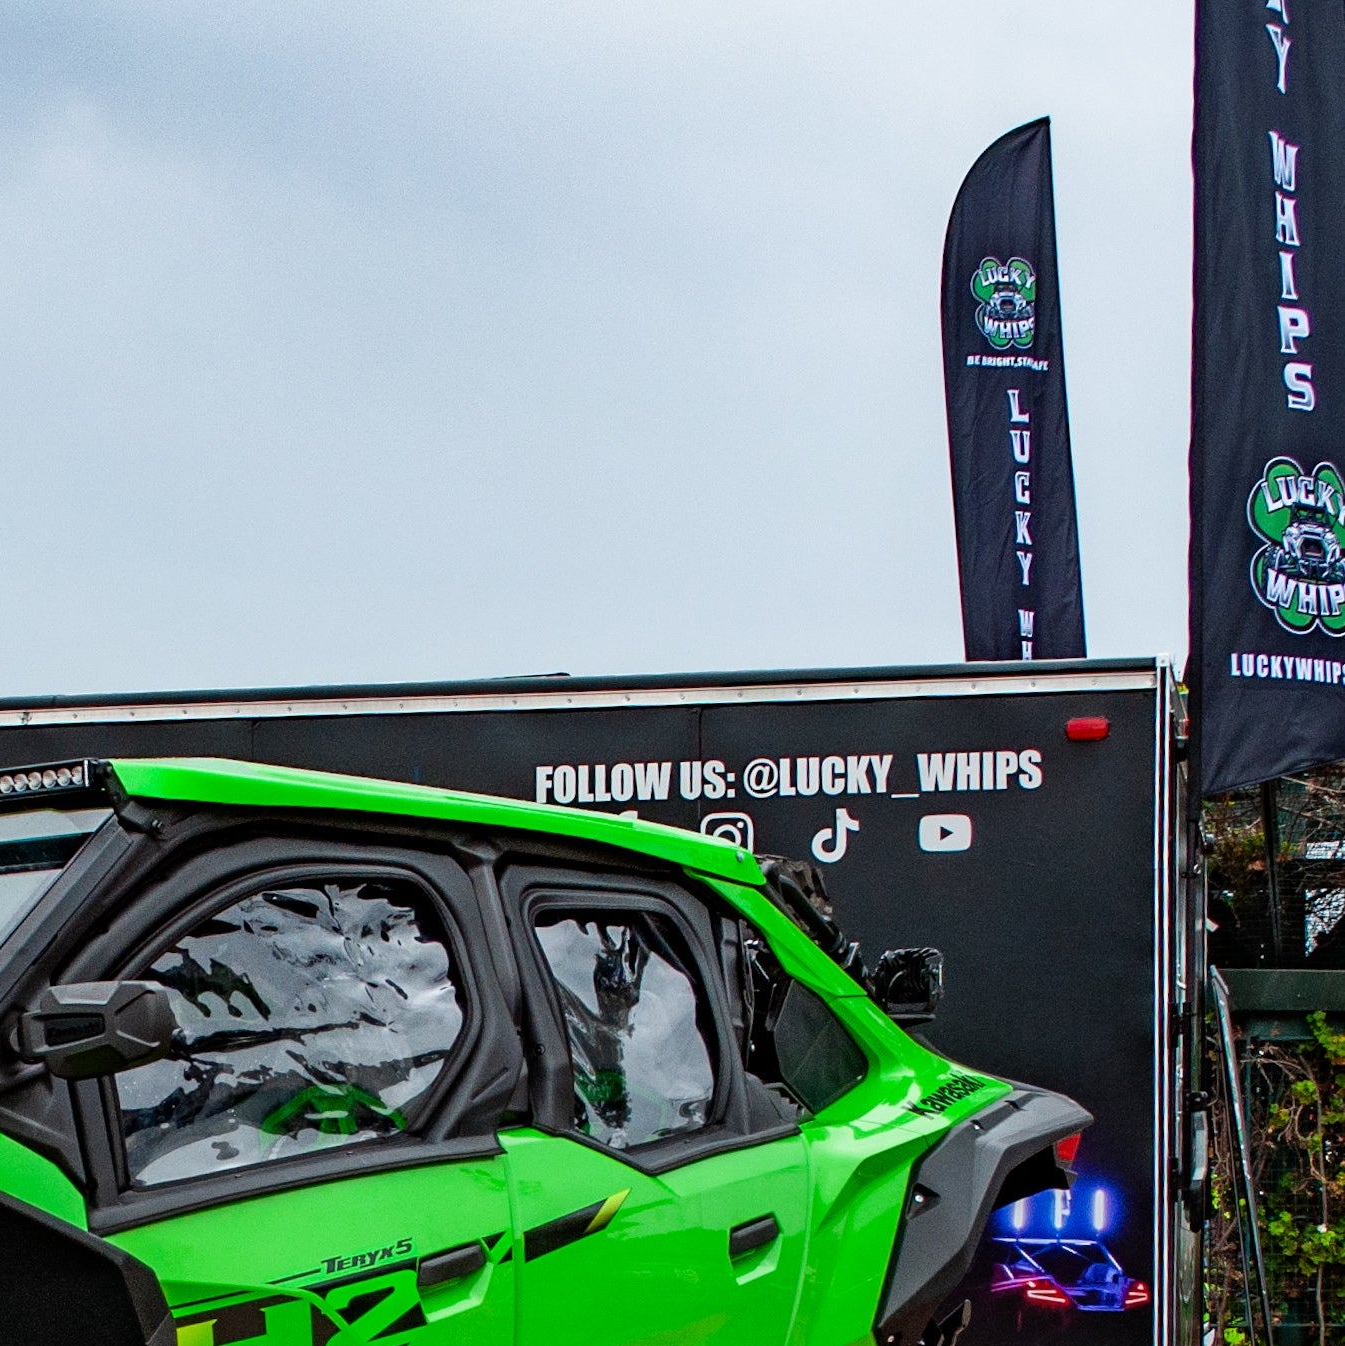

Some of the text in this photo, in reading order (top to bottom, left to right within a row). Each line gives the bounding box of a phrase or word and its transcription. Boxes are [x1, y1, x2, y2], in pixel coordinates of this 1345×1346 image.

[979, 266, 1036, 289] LUCKY
[1268, 130, 1316, 412] WHIPS
[1007, 389, 1034, 586] LUCKY
[535, 749, 1043, 804] FOLLOW US: @LUCKY_WHIPS
[901, 1069, 986, 1120] Kawasaki
